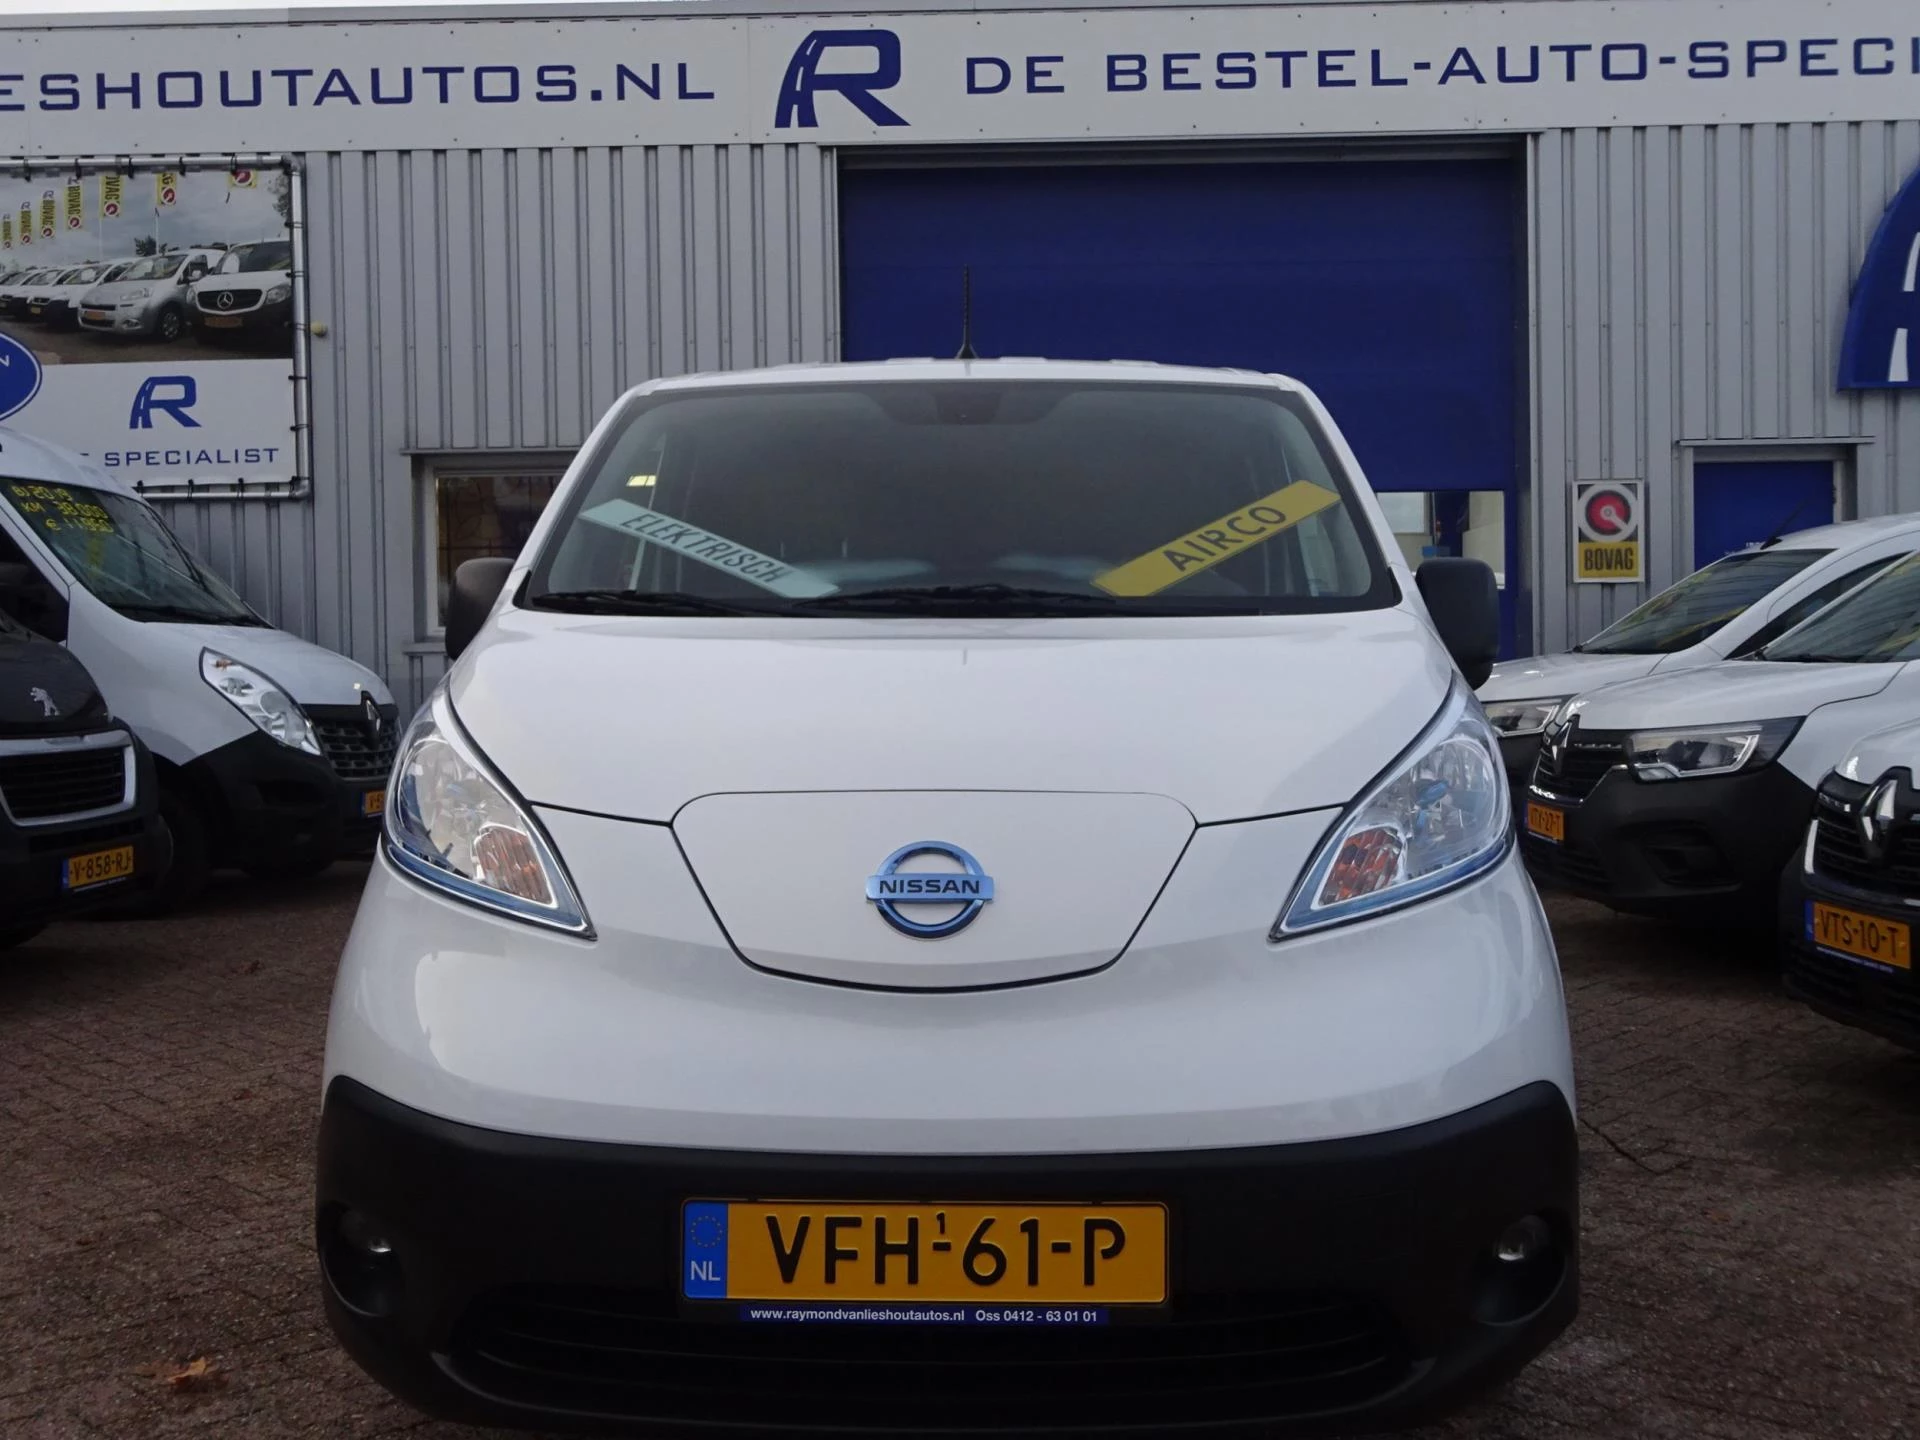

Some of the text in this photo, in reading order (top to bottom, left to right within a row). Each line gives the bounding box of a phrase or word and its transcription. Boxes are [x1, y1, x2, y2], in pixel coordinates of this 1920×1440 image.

[966, 55, 1065, 95] DE
[104, 448, 279, 467] SPECIALIST
[619, 513, 788, 584] ELEKTRISCH
[1161, 506, 1287, 573] AIRCO
[1584, 547, 1634, 571] BOVAG
[879, 879, 981, 895] NISSAN
[1821, 909, 1899, 959] VTS-10-T
[690, 1261, 721, 1282] NL
[751, 1308, 965, 1323] www.raymondvanlieshoutautos.nl
[976, 1309, 1001, 1322] Oss
[1003, 1309, 1034, 1323] 0412
[1046, 1310, 1062, 1322] 63
[1064, 1310, 1081, 1322] 01
[1083, 1310, 1097, 1323] 01
